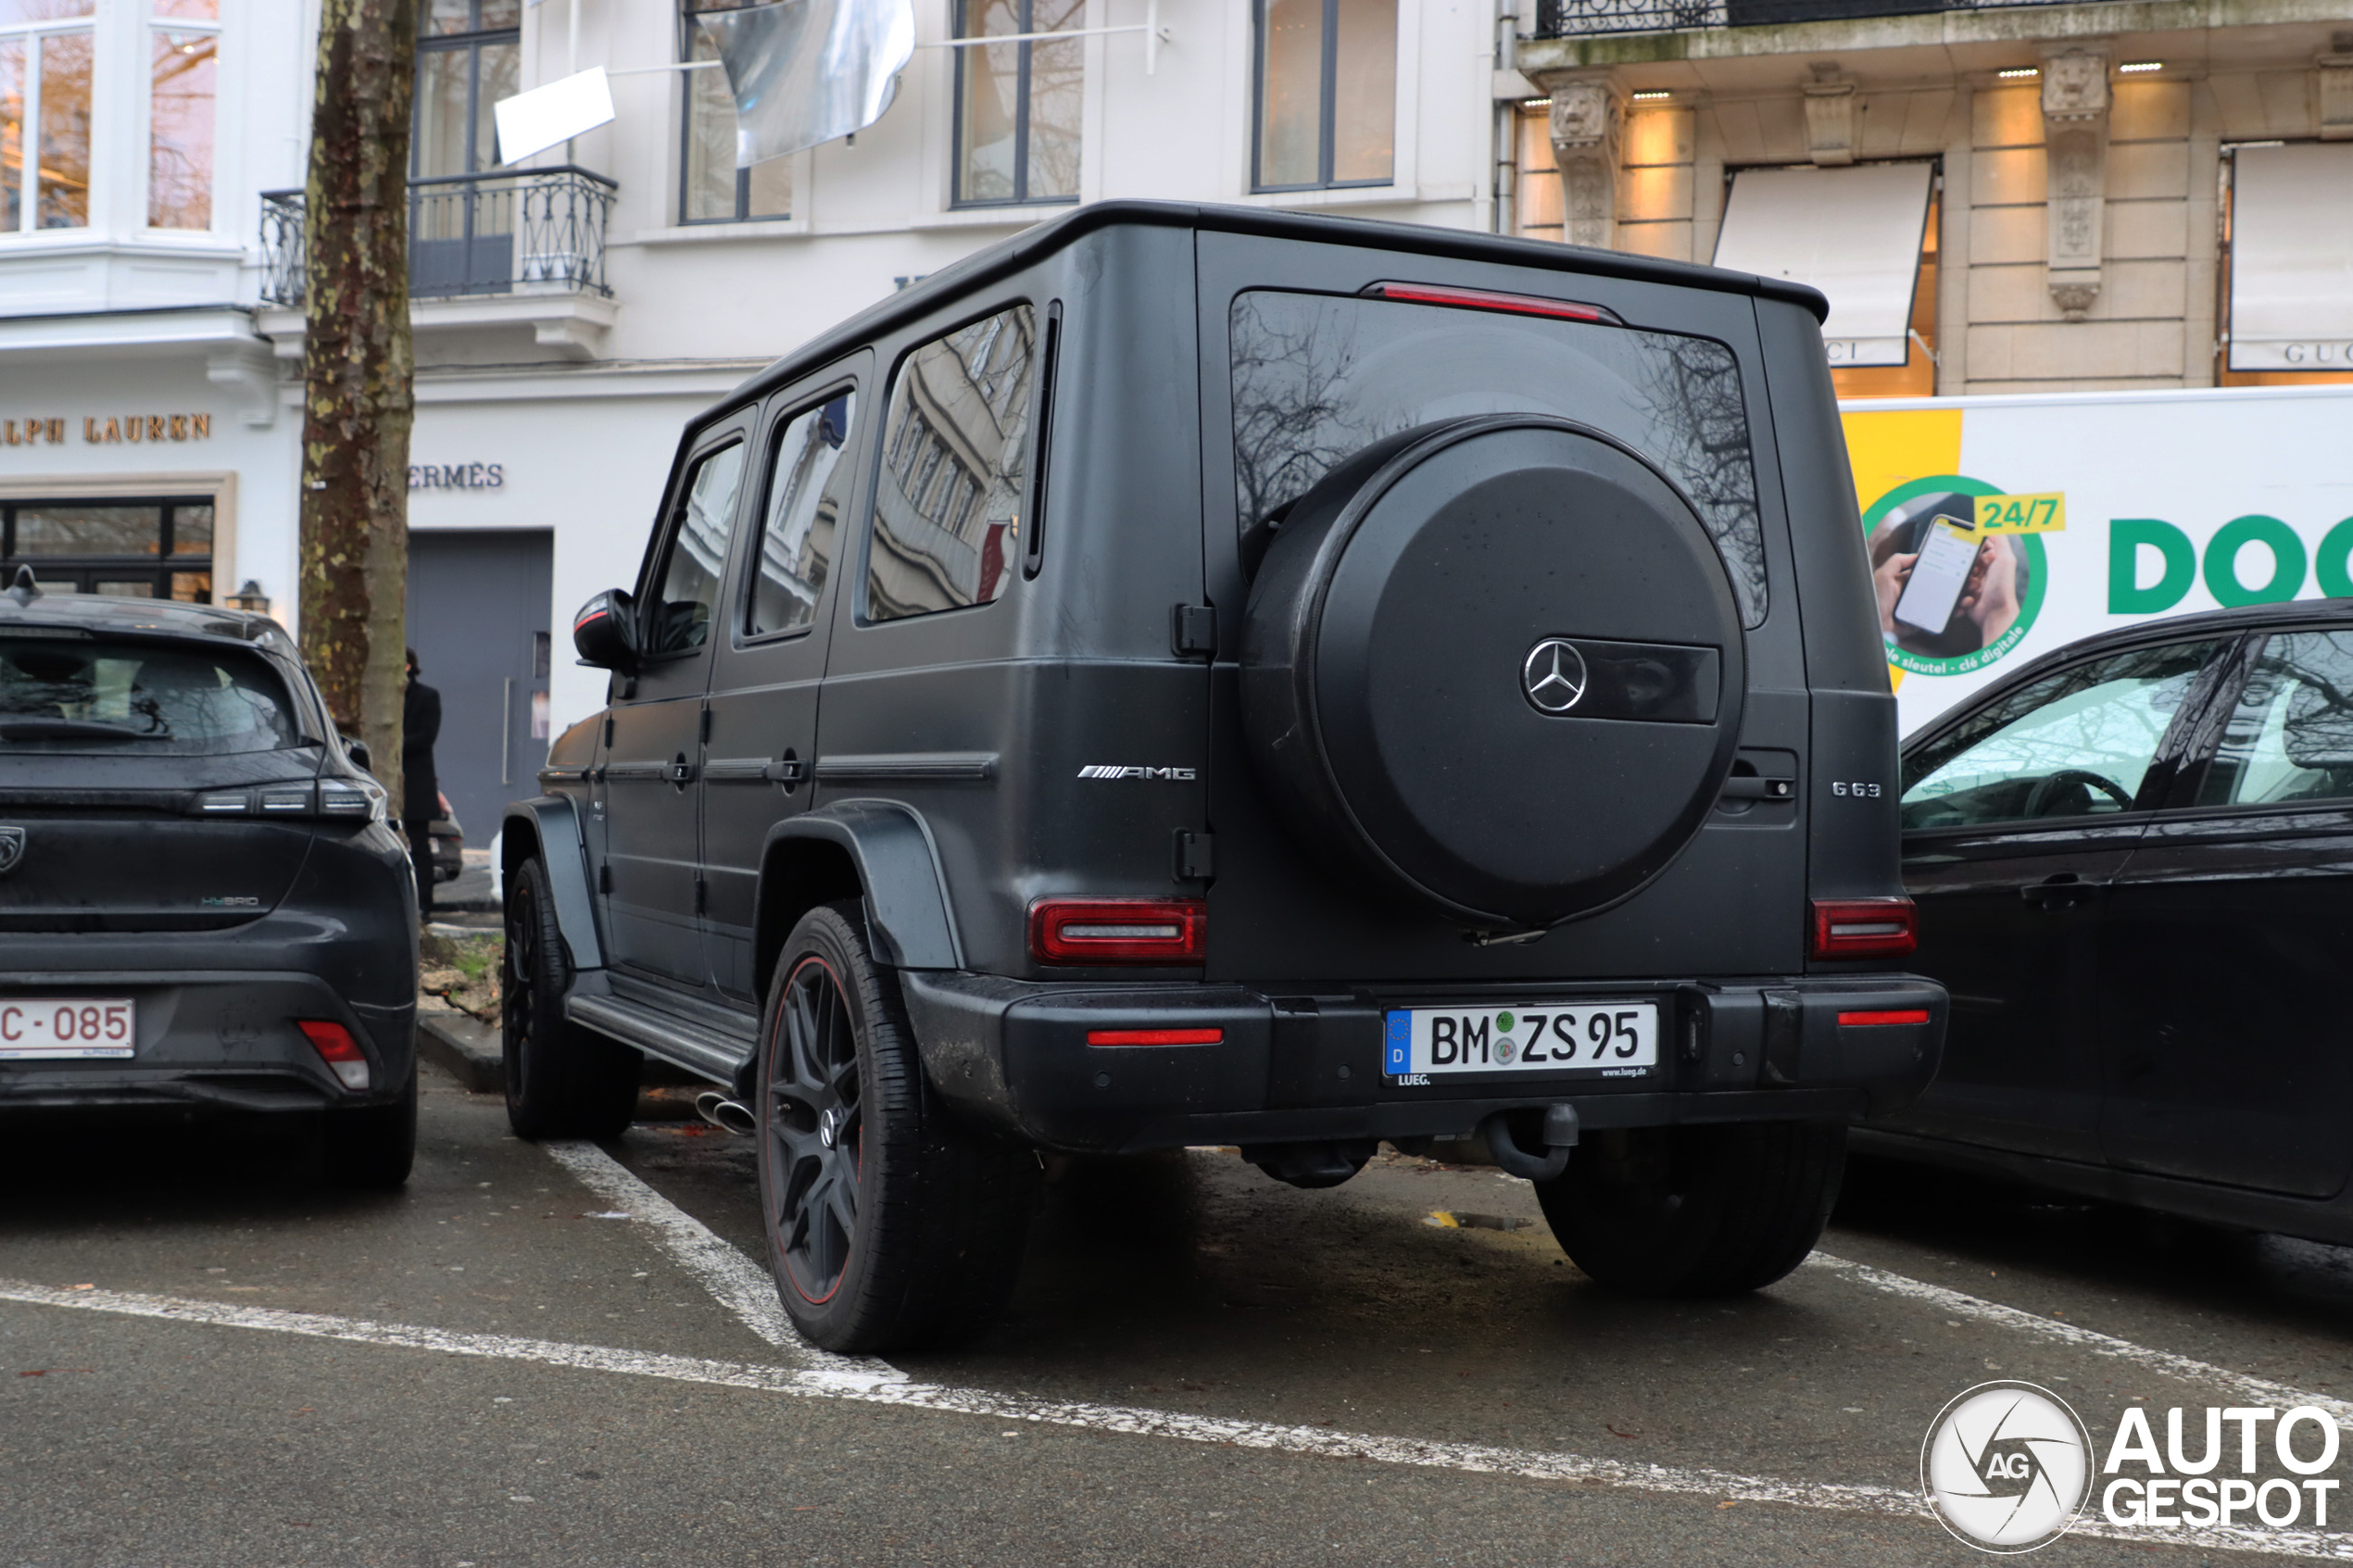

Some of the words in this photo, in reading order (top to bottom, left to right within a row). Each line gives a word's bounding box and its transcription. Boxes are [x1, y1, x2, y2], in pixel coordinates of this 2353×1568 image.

[0, 419, 65, 445] LPH
[84, 413, 209, 443] LAUREN
[1983, 499, 2058, 528] 24/7
[1902, 657, 1946, 674] sleutel
[1958, 656, 1978, 671] clé
[1981, 625, 2024, 663] digitale
[202, 897, 258, 906] HYBRID
[1431, 1016, 1490, 1065] BM
[1521, 1013, 1577, 1062] ZS
[1588, 1011, 1639, 1060] 95
[1392, 1048, 1403, 1063] D
[1398, 1074, 1430, 1085] LUEG.
[1602, 1066, 1647, 1078] www.lueg.de
